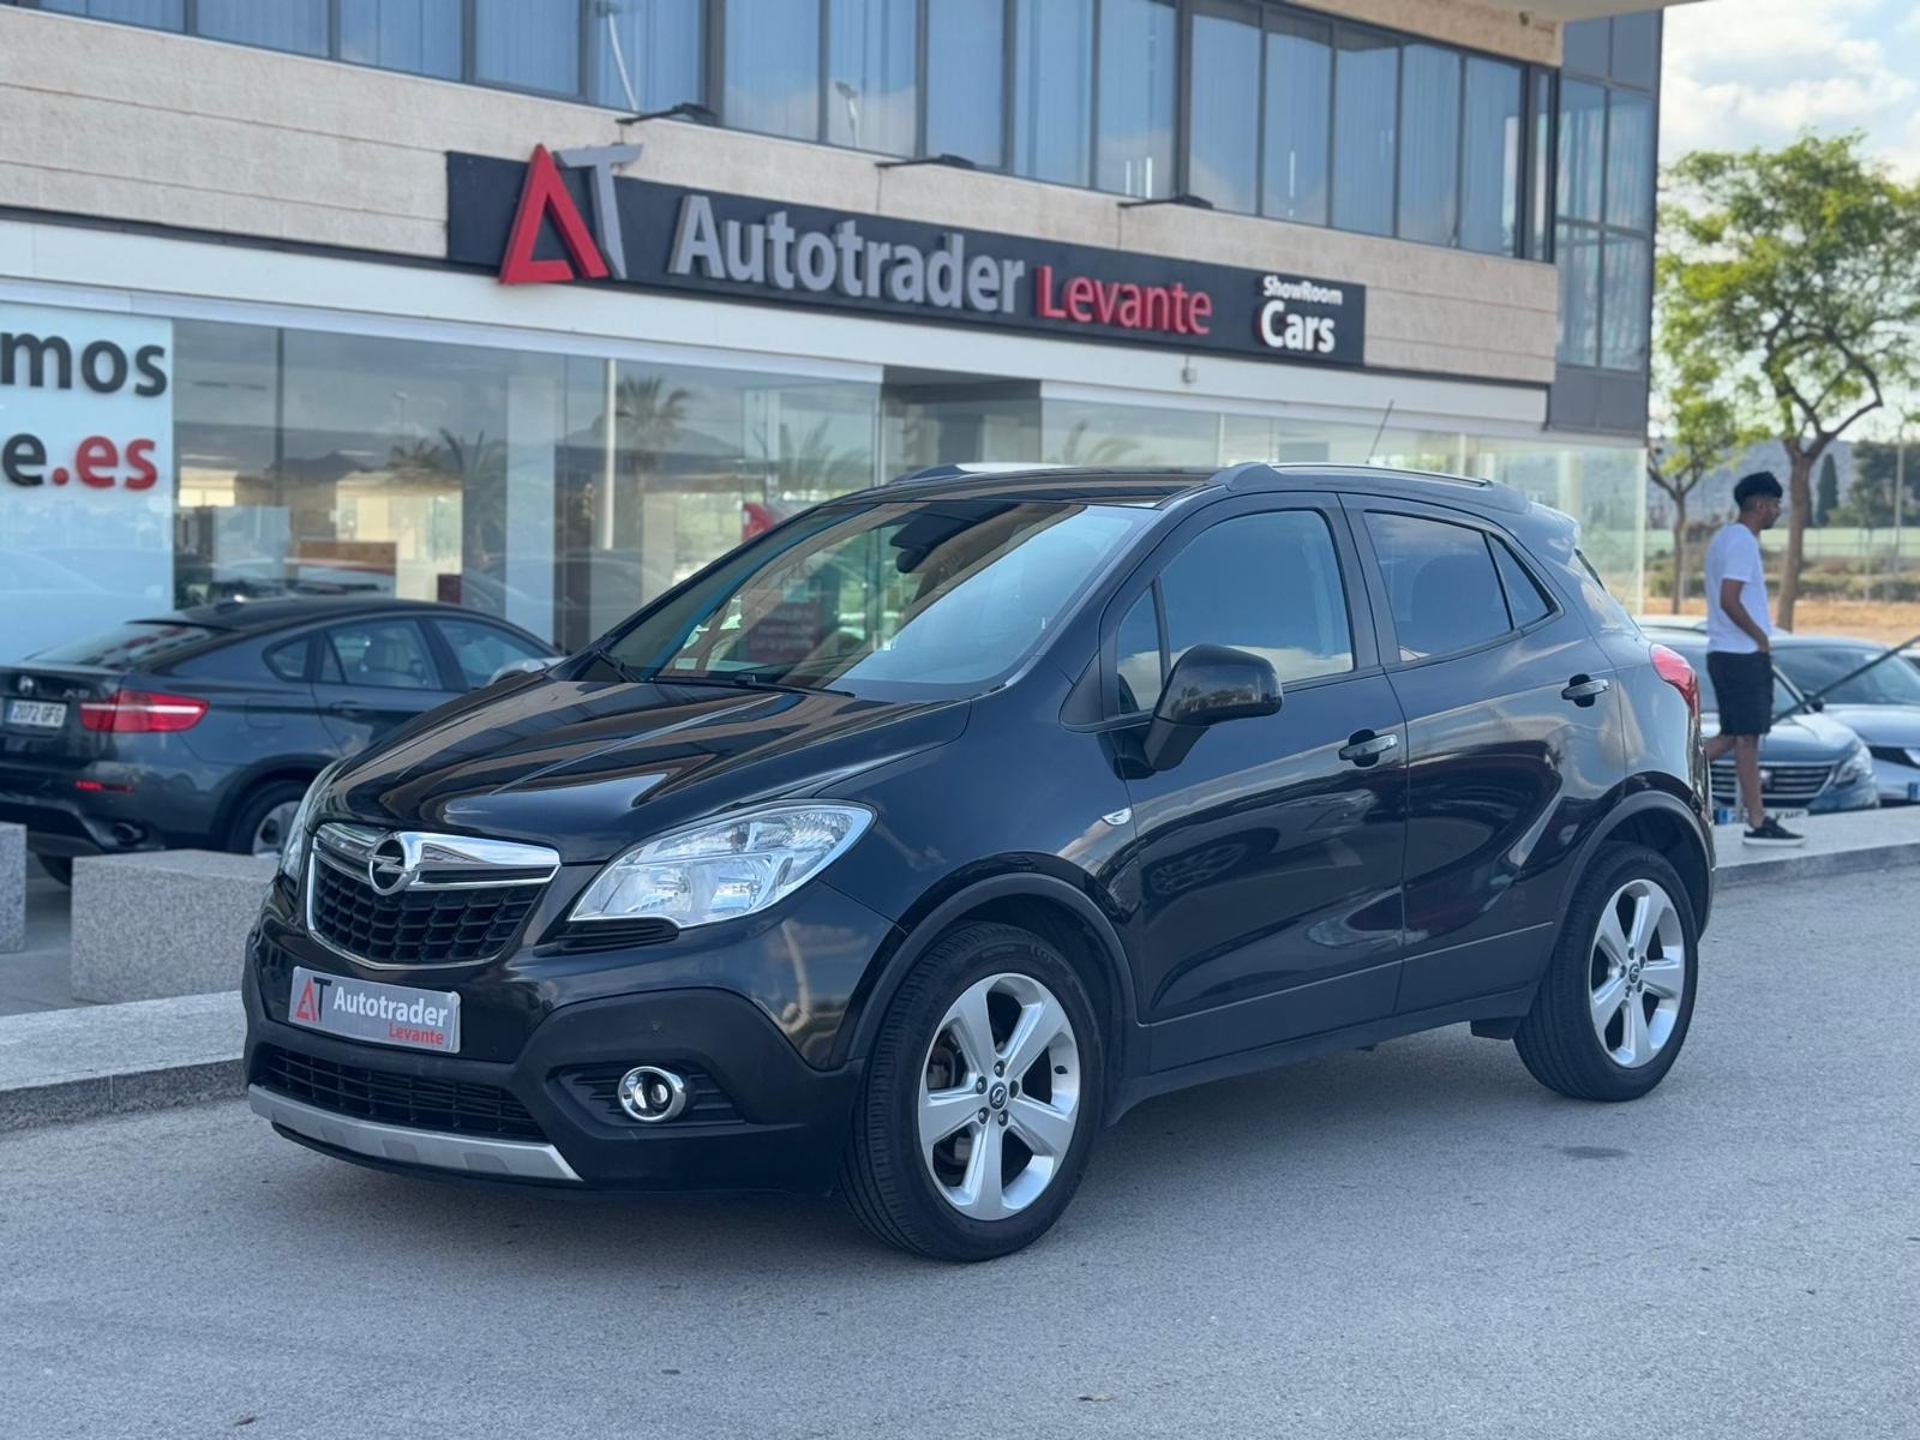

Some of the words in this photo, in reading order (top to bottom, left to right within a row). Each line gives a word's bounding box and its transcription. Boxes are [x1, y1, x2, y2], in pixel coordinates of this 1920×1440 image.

[668, 194, 1025, 314] Autotrader
[1036, 264, 1213, 335] Levante
[1262, 274, 1343, 305] ShowRoom
[1260, 299, 1336, 353] Cars
[0, 331, 168, 397] mos
[2, 432, 158, 491] e.es
[333, 986, 449, 1027] Autotrader
[387, 1021, 445, 1045] Levante
